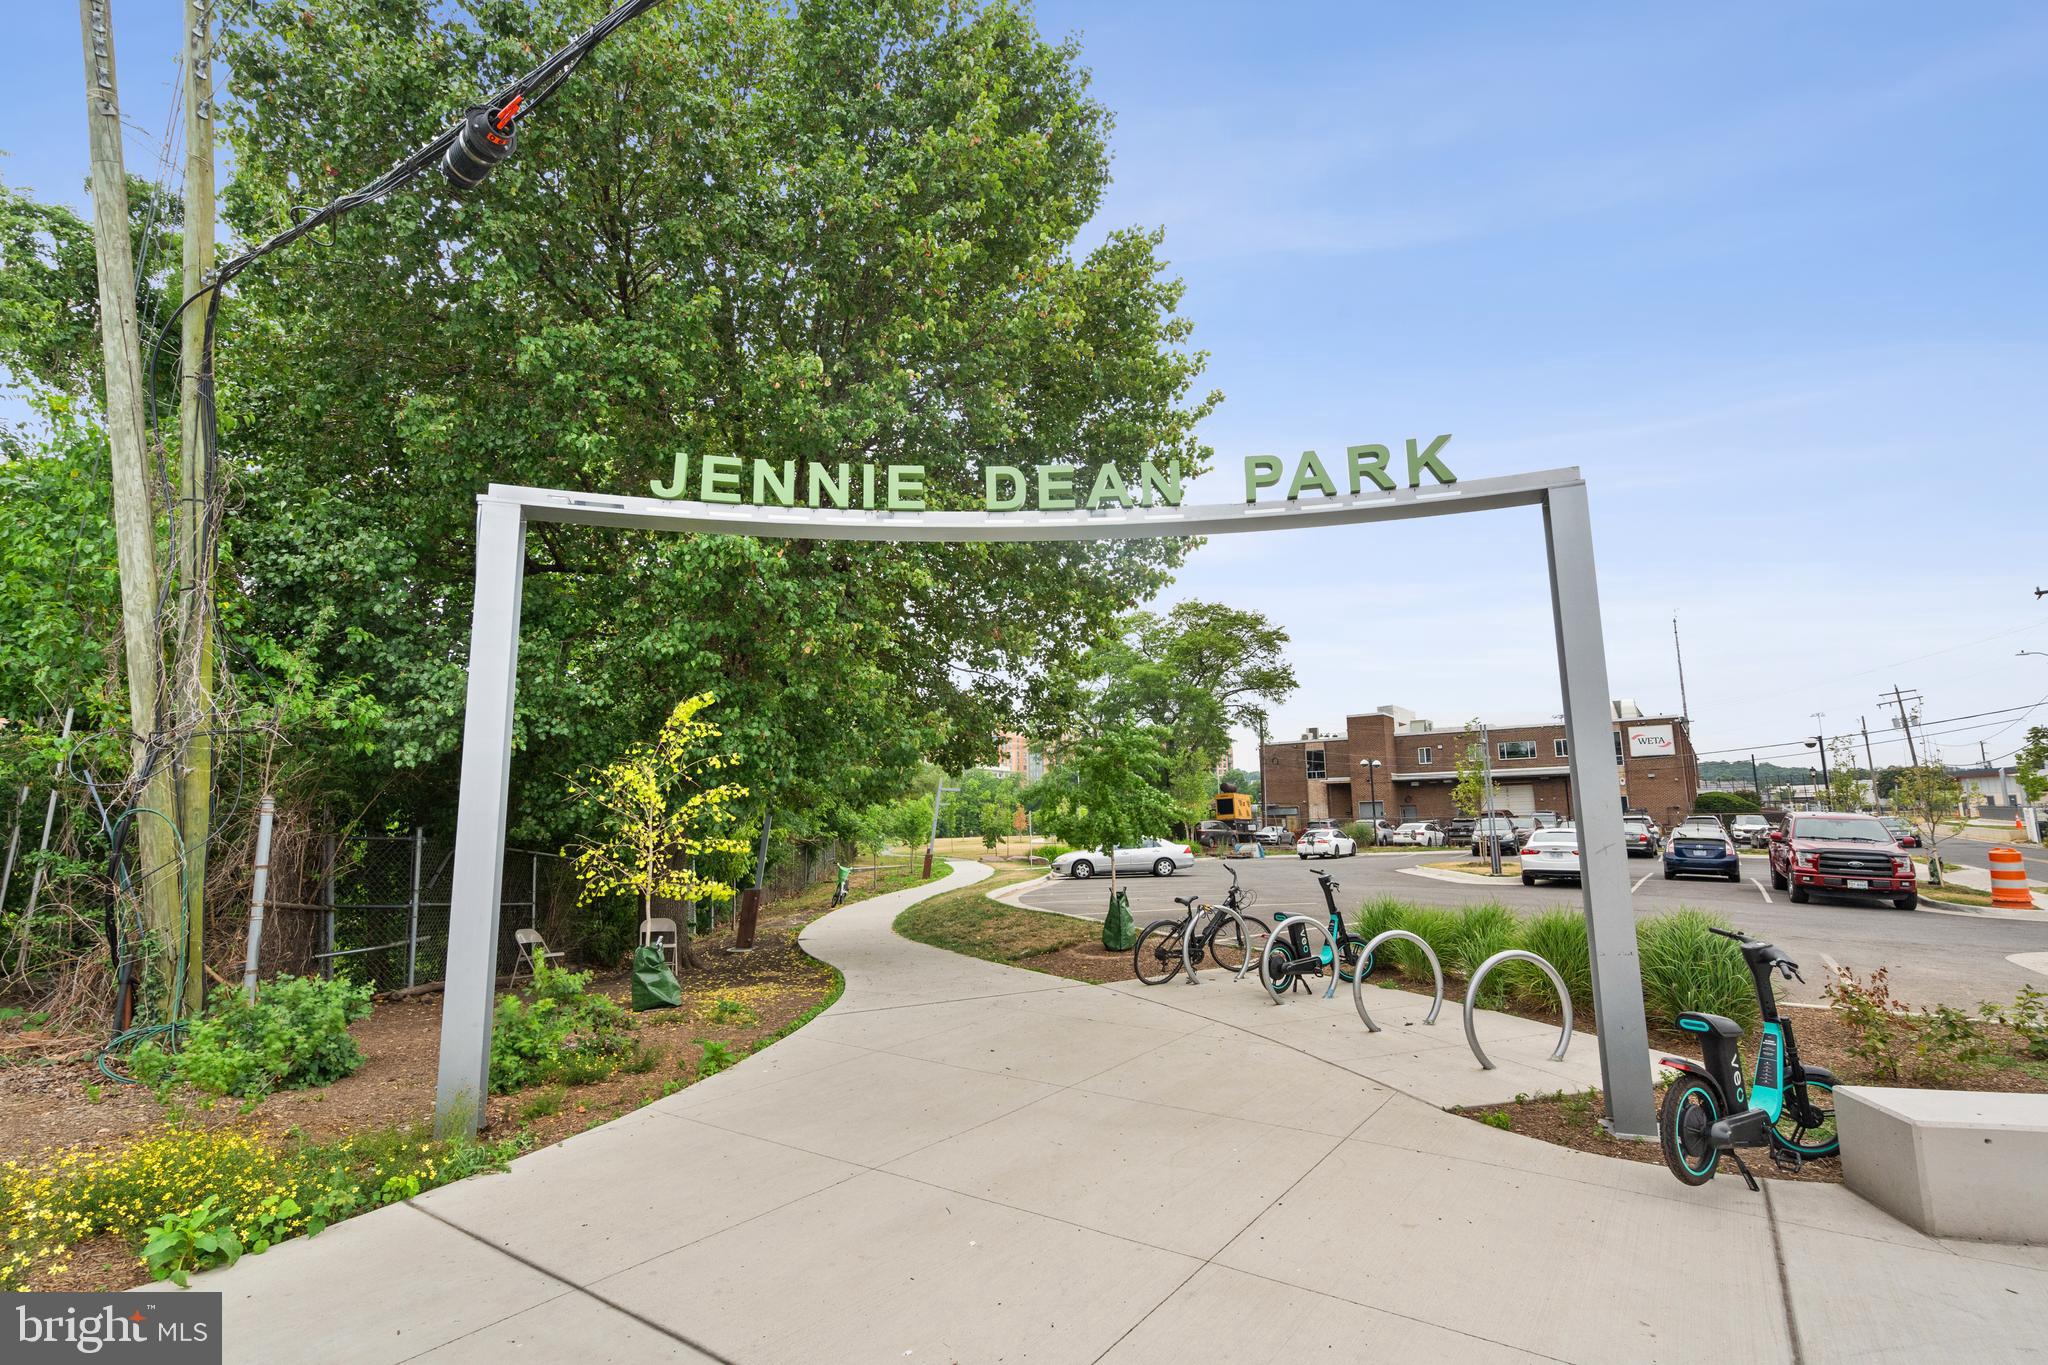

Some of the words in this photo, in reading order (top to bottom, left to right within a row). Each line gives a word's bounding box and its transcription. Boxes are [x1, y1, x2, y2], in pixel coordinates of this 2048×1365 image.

[650, 451, 927, 512] JENNIE
[986, 459, 1183, 512] DEAN
[1244, 433, 1458, 504] PARK
